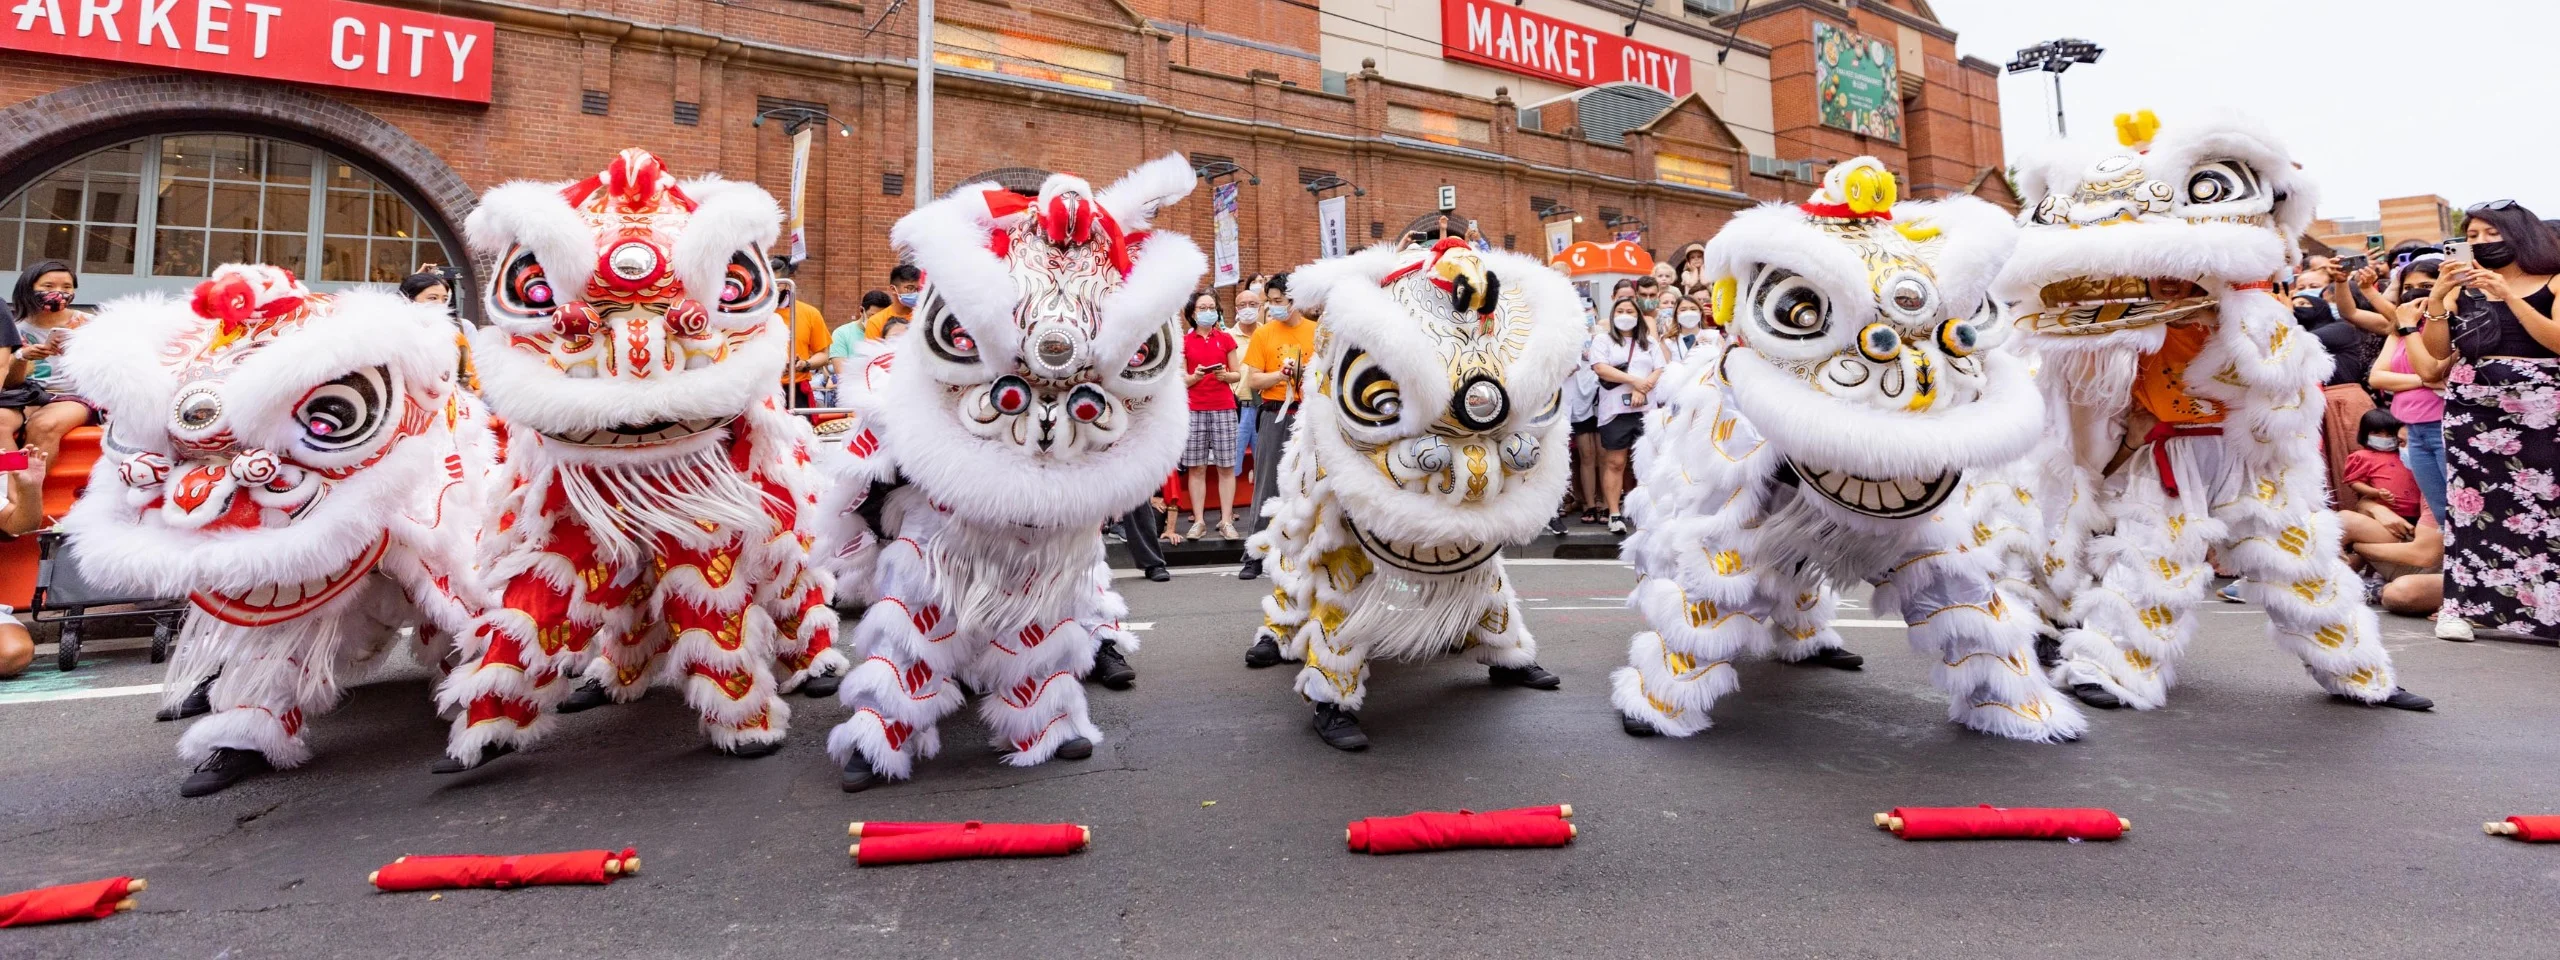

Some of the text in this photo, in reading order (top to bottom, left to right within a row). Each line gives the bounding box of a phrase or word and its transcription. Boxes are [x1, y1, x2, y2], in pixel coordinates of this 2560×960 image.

[11, 0, 478, 83] ARKET CITY
[1466, 2, 1678, 97] MARKET CITY
[1442, 188, 1453, 206] E
